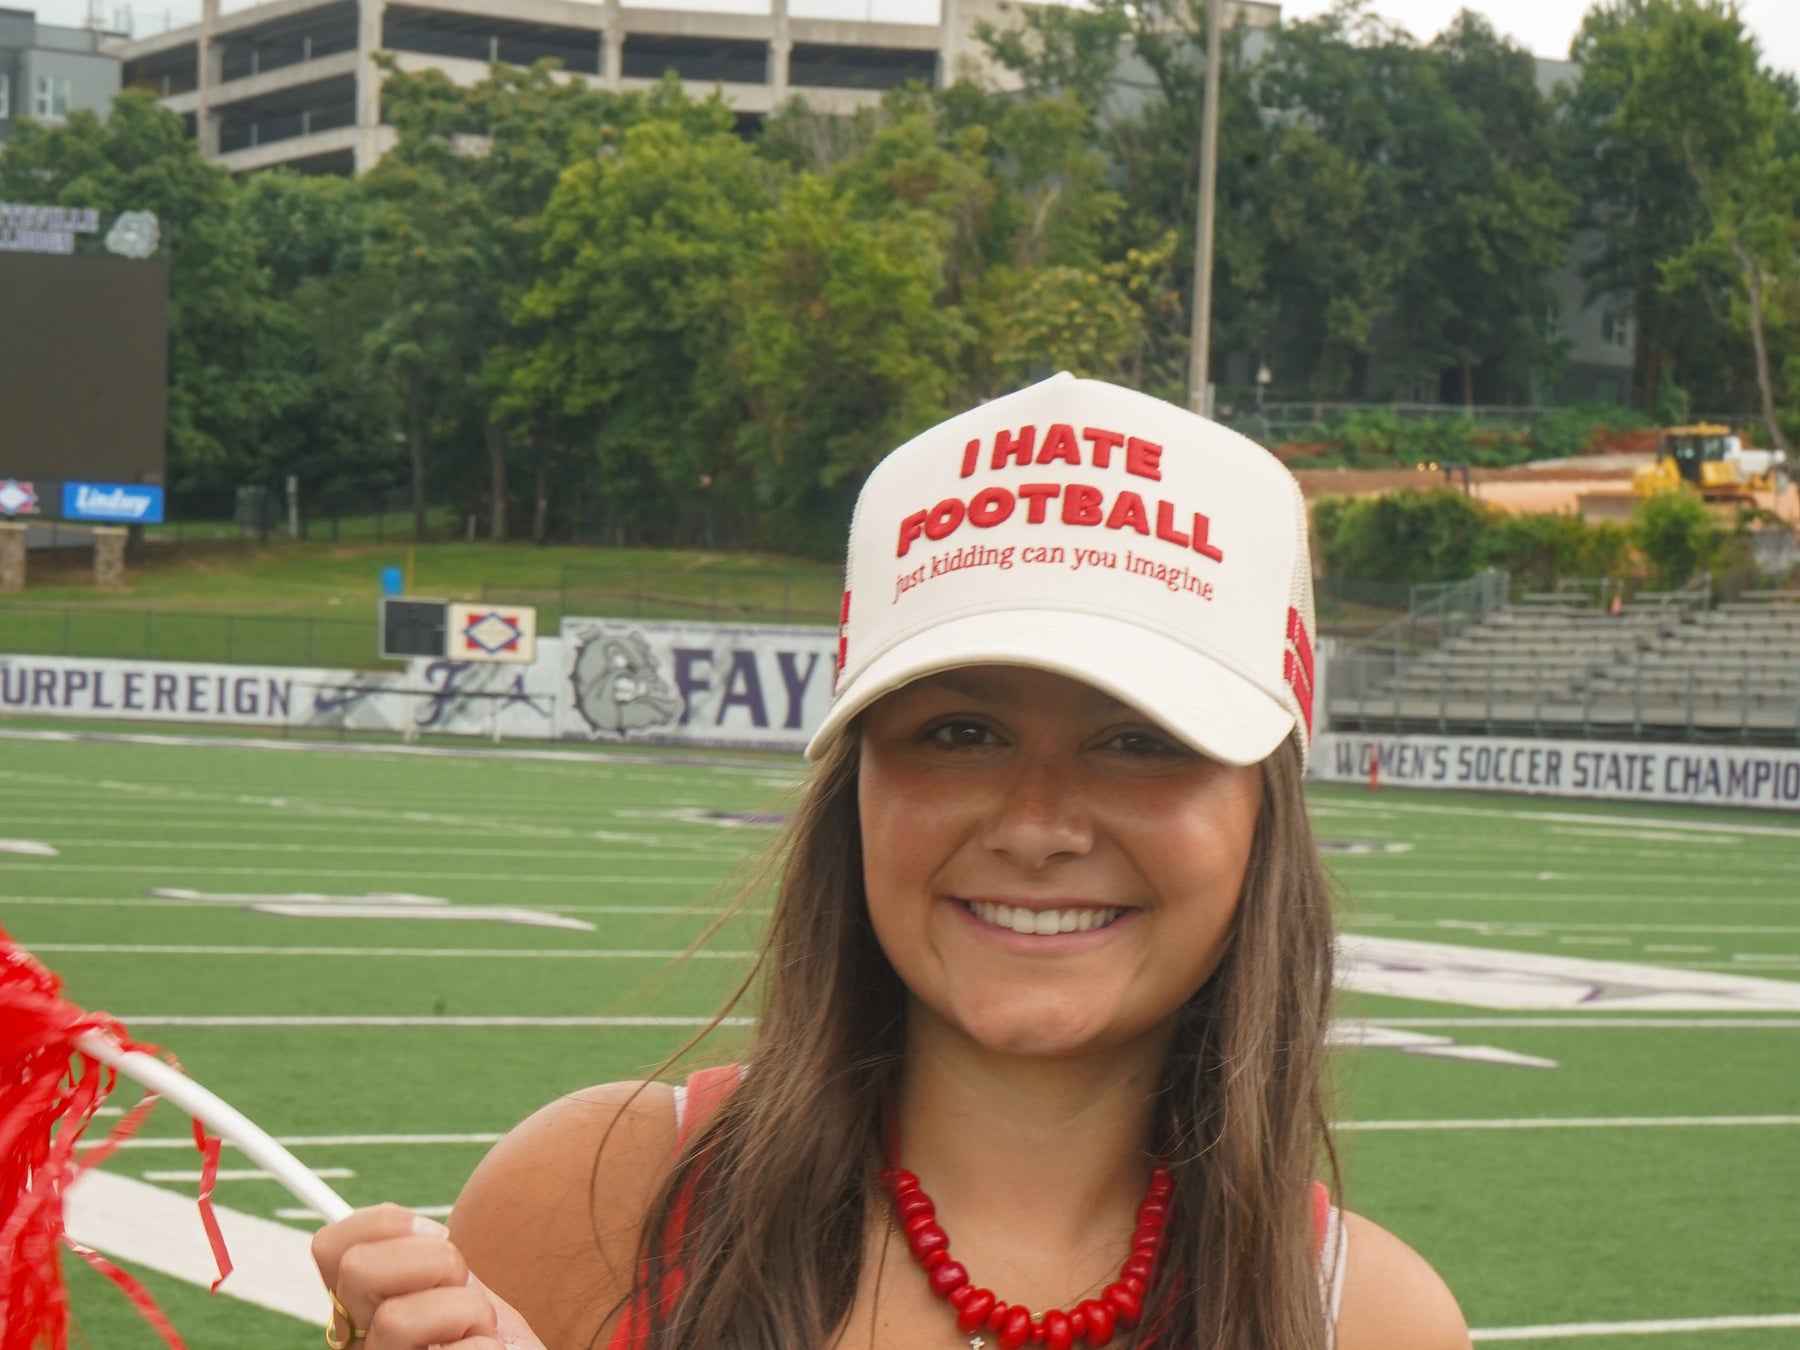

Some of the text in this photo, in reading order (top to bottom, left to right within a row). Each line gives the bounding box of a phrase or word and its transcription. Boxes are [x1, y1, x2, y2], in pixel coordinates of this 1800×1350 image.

[960, 422, 1164, 482] I HATE
[896, 483, 1224, 563] FOOTBALL
[892, 545, 1214, 604] just kidding can you imagine
[672, 648, 839, 729] FAY
[1457, 745, 1562, 787] SOCCER
[1573, 751, 1656, 792] STATE
[1665, 755, 1800, 800] CHAMPIO
